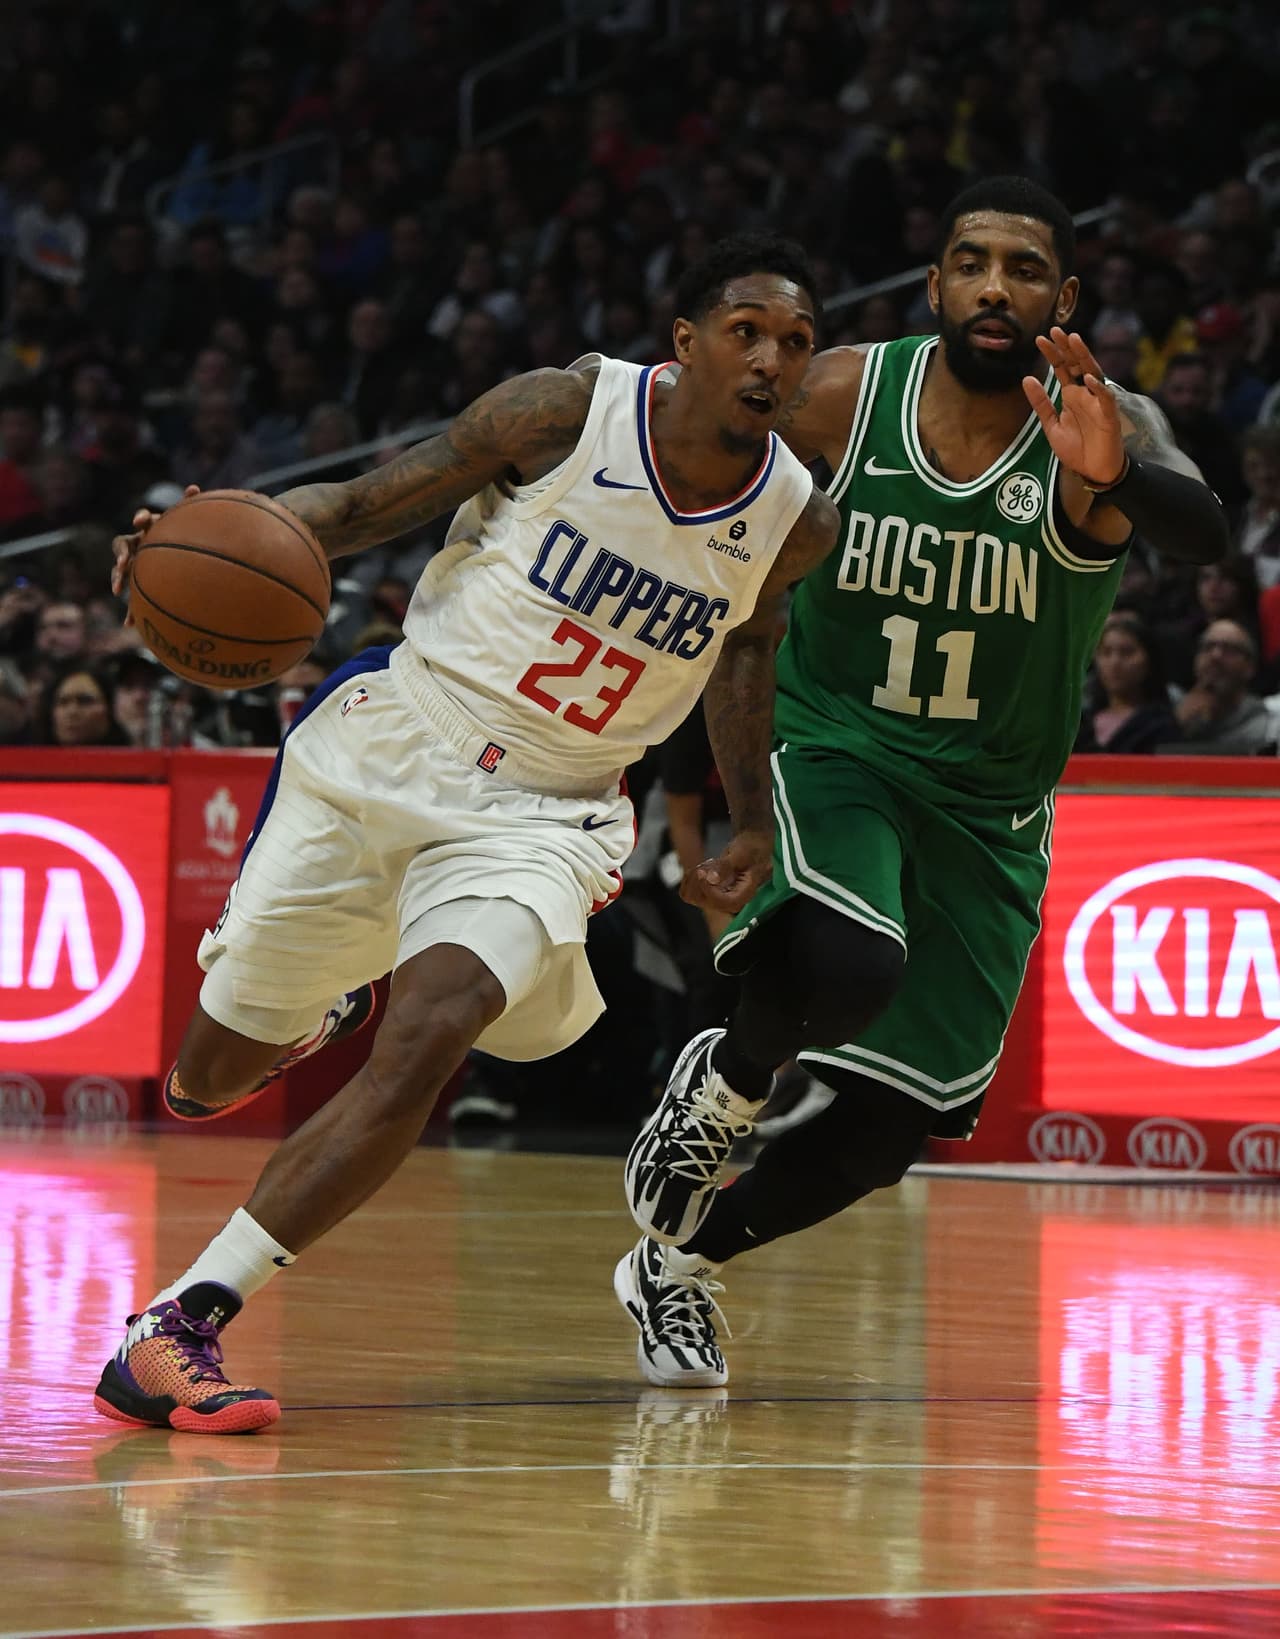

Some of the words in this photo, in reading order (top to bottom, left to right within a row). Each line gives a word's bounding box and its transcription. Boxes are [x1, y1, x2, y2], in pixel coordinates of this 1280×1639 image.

[528, 519, 730, 661] CLIPPERS
[706, 535, 752, 563] bumble
[836, 510, 1039, 623] BOSTON
[516, 617, 647, 736] 23
[871, 614, 980, 720] 11
[0, 867, 99, 991] IA
[1110, 904, 1280, 1020] KIA
[1040, 1124, 1093, 1159] KIA
[1140, 1130, 1194, 1167] KIA
[1242, 1136, 1280, 1173] KI
